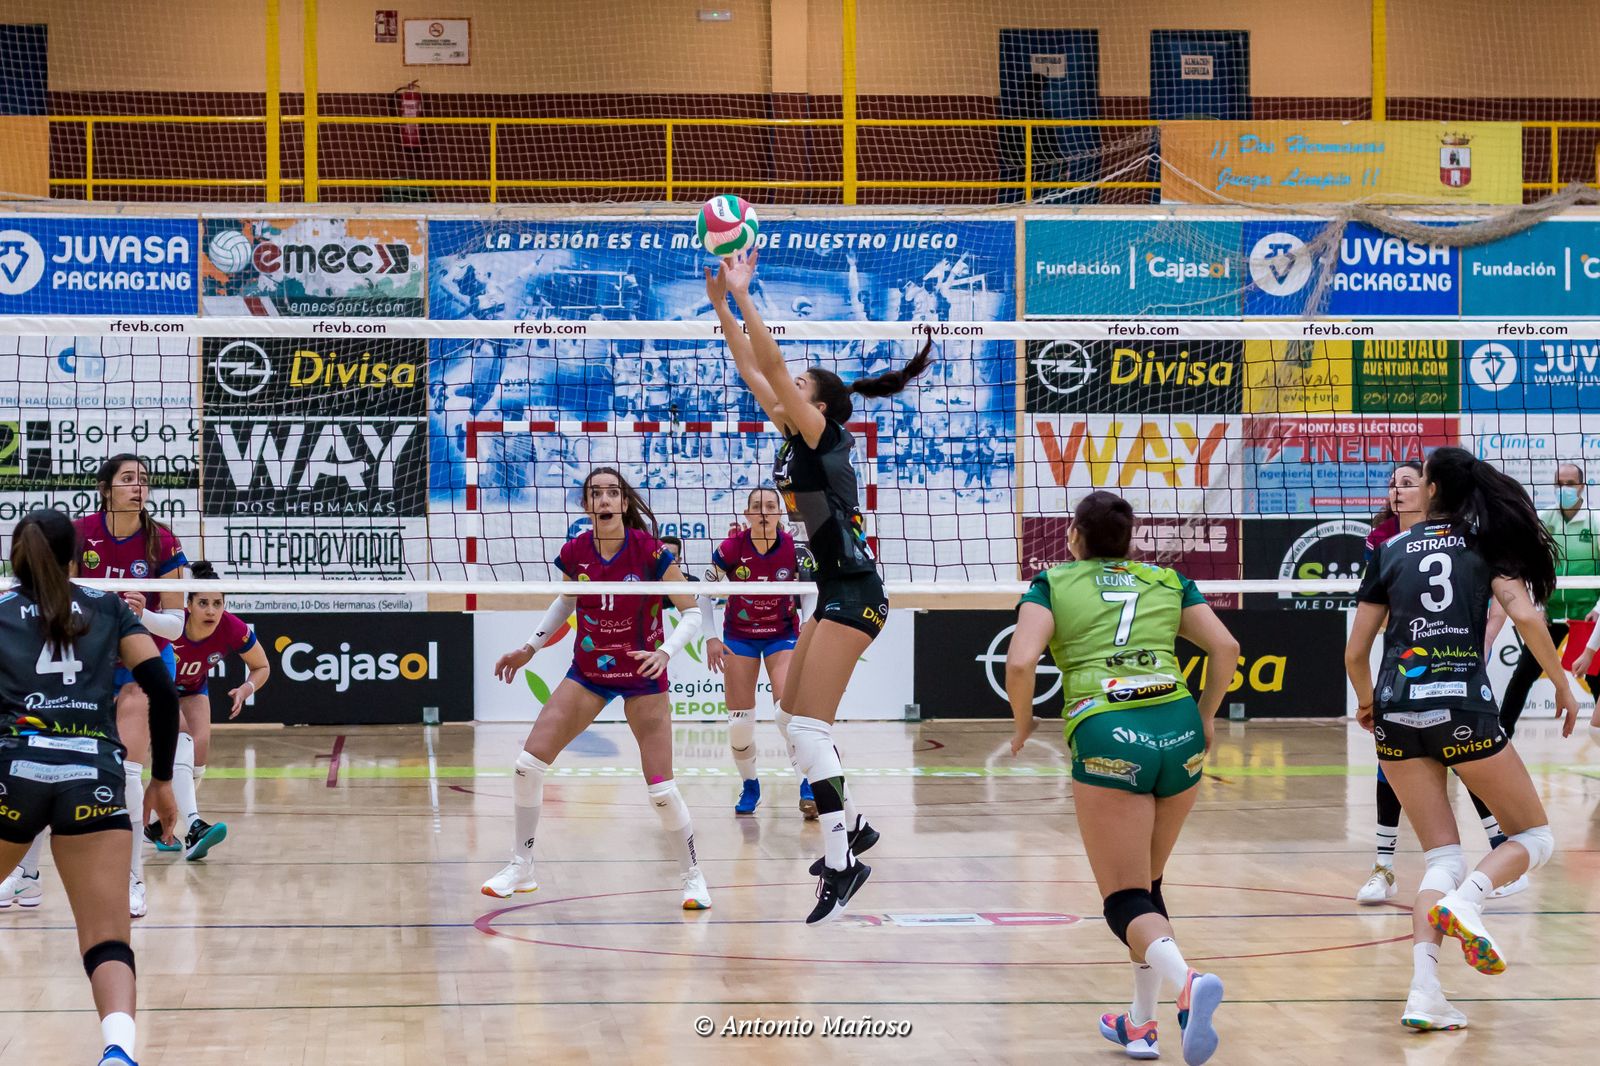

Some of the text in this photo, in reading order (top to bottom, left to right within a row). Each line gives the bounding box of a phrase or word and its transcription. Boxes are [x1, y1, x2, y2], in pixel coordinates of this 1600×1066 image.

[51, 235, 190, 265] JUVASA
[485, 233, 511, 249] LA
[518, 229, 600, 249] PASIÓN
[607, 233, 632, 249] ES
[639, 233, 663, 249] EL
[755, 233, 781, 249] DE
[787, 233, 887, 249] NUESTRO
[891, 233, 958, 252] JUEGO
[253, 243, 373, 275] emec
[1473, 261, 1556, 276] Fundación
[1036, 257, 1230, 284] Fundación Cajasol
[51, 271, 192, 291] PACKAGING
[109, 320, 185, 333] rfevb.com
[312, 320, 387, 333] rfevb.com
[513, 321, 587, 334] rfevb.com
[1107, 323, 1179, 336] rfevb.com
[1303, 324, 1374, 337] rfevb.com
[1497, 324, 1568, 337] rfevb.com
[1363, 340, 1448, 359] ANDEVALO
[290, 350, 416, 388] Divisa
[1110, 348, 1233, 387] Divisa
[1362, 361, 1448, 377] AVENTURA.COM
[1298, 422, 1356, 434] MONTAJES
[214, 424, 417, 492] WAY
[1036, 421, 1230, 488] WAY
[236, 501, 396, 513] DOS HERMANAS
[1406, 535, 1467, 554] ESTRADA
[1418, 552, 1454, 613] 3
[333, 600, 376, 611] Hermanas
[378, 600, 413, 612] (Sevilla)
[1101, 591, 1140, 646] 7
[36, 640, 83, 685] 4
[180, 661, 202, 676] 10
[281, 641, 438, 693] Cajasol
[1442, 737, 1493, 759] Divisa
